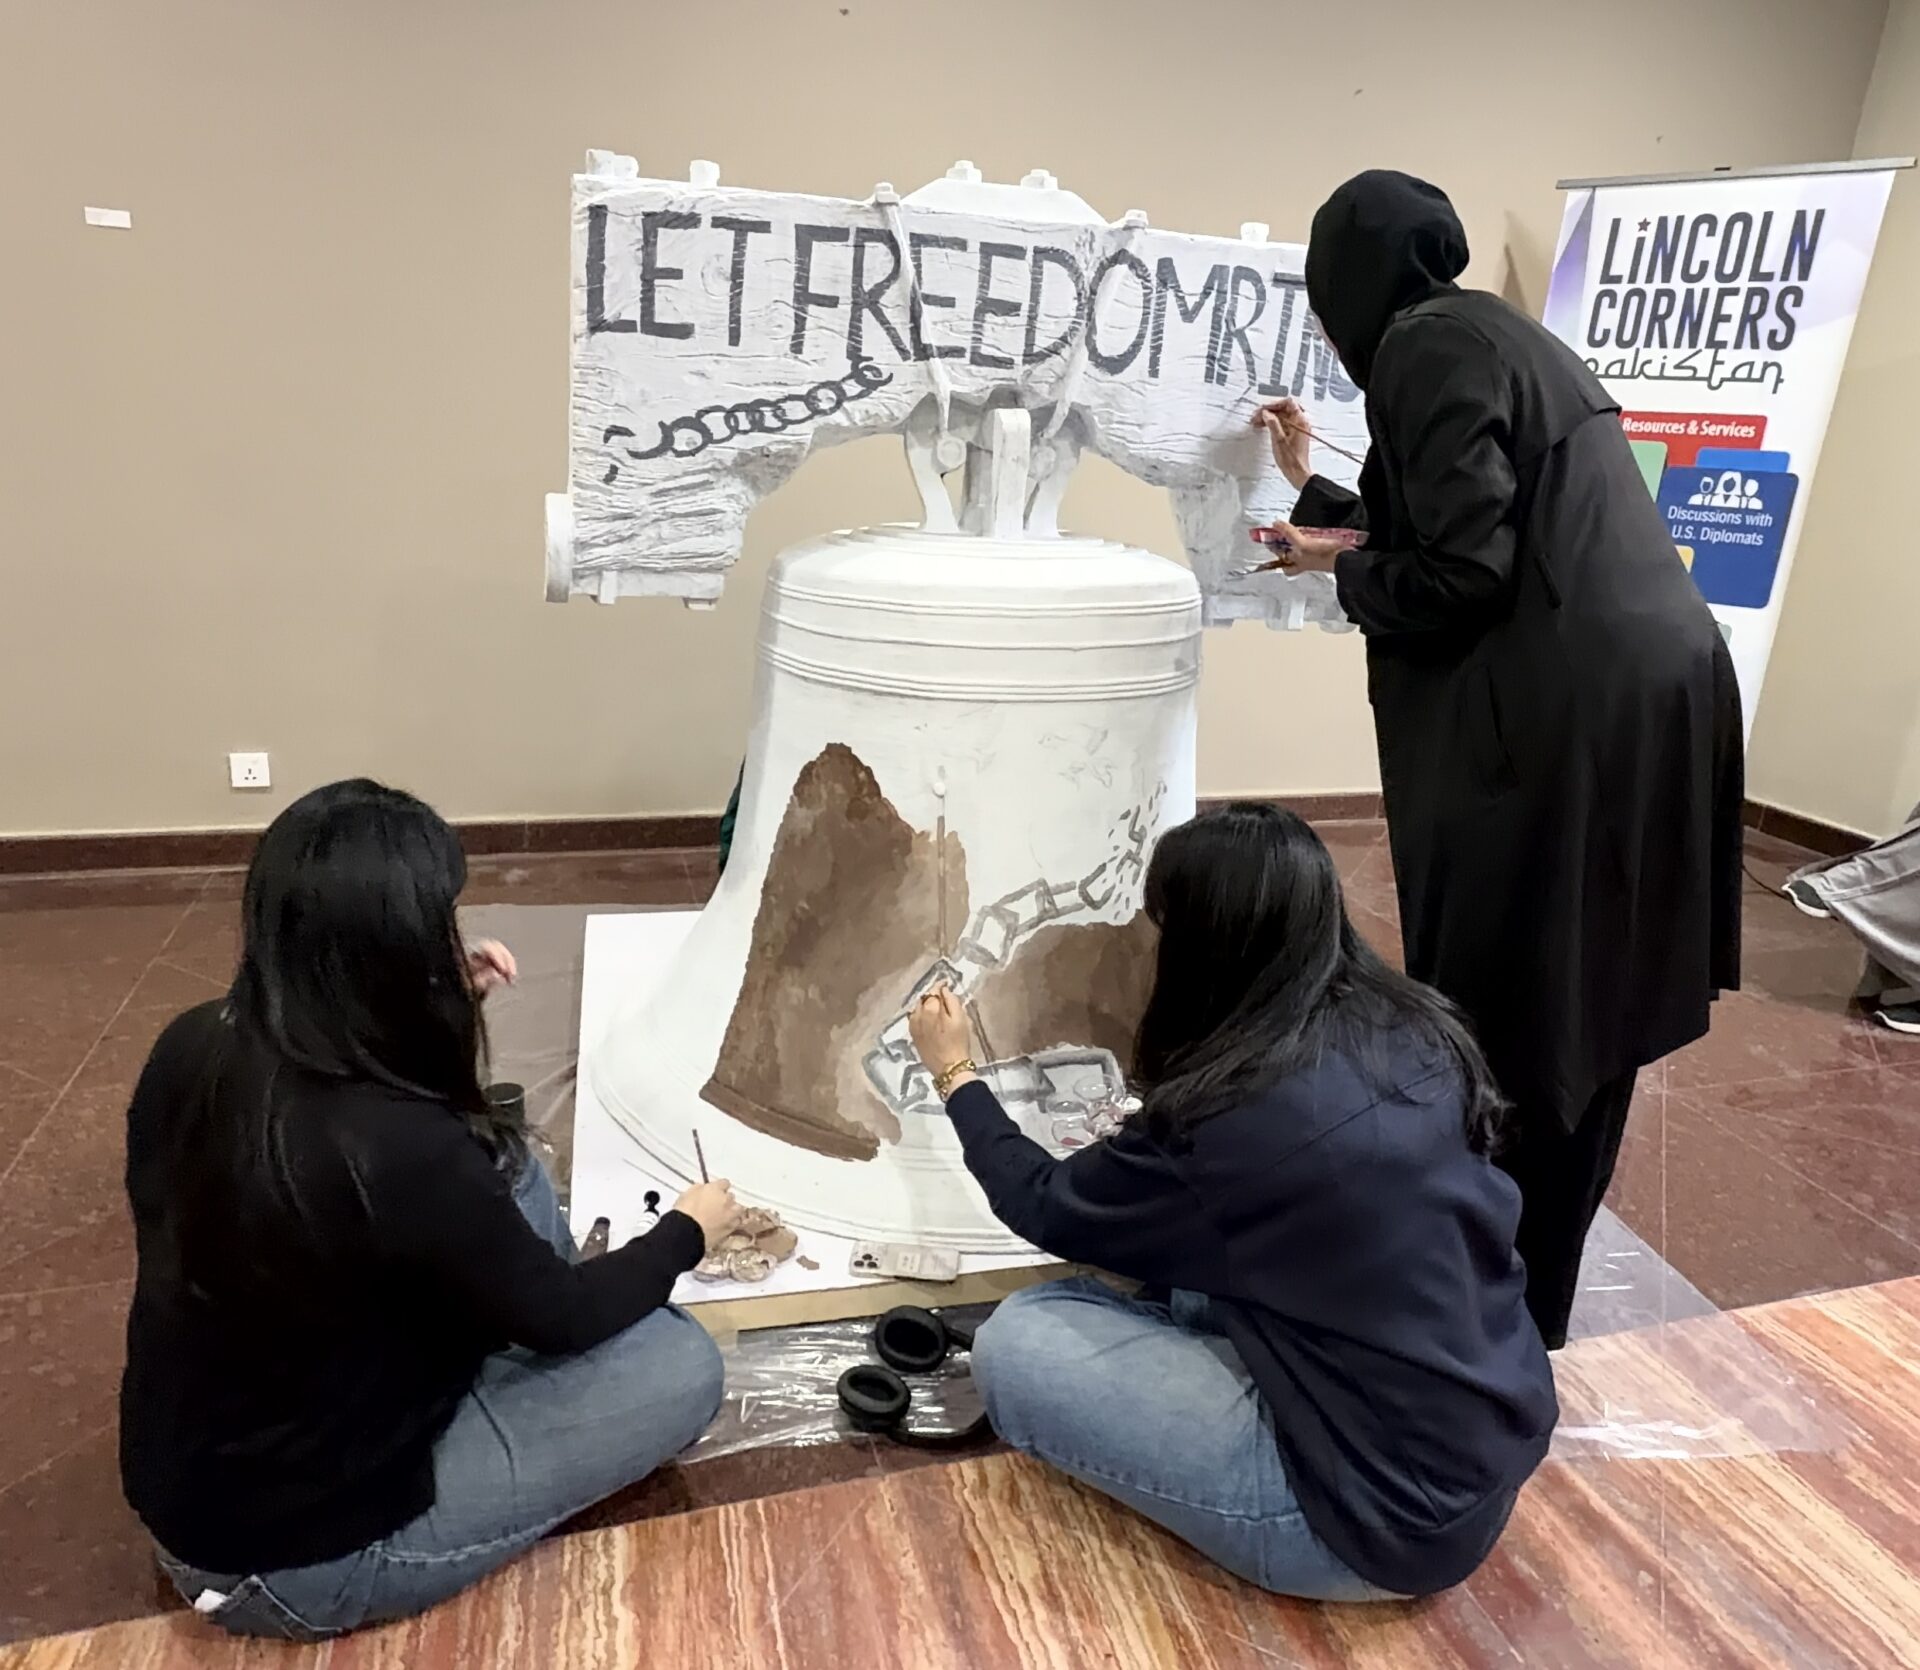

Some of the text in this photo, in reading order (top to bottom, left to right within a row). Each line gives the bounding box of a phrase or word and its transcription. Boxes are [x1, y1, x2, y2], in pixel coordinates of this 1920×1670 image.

[586, 204, 771, 347] LET
[789, 223, 1230, 379] FREEDOM
[1586, 285, 1804, 351] CORNERS
[1622, 417, 1756, 438] Resources & Services
[1667, 505, 1773, 527] Discussions with
[1671, 525, 1764, 546] U.S. Diplomats
